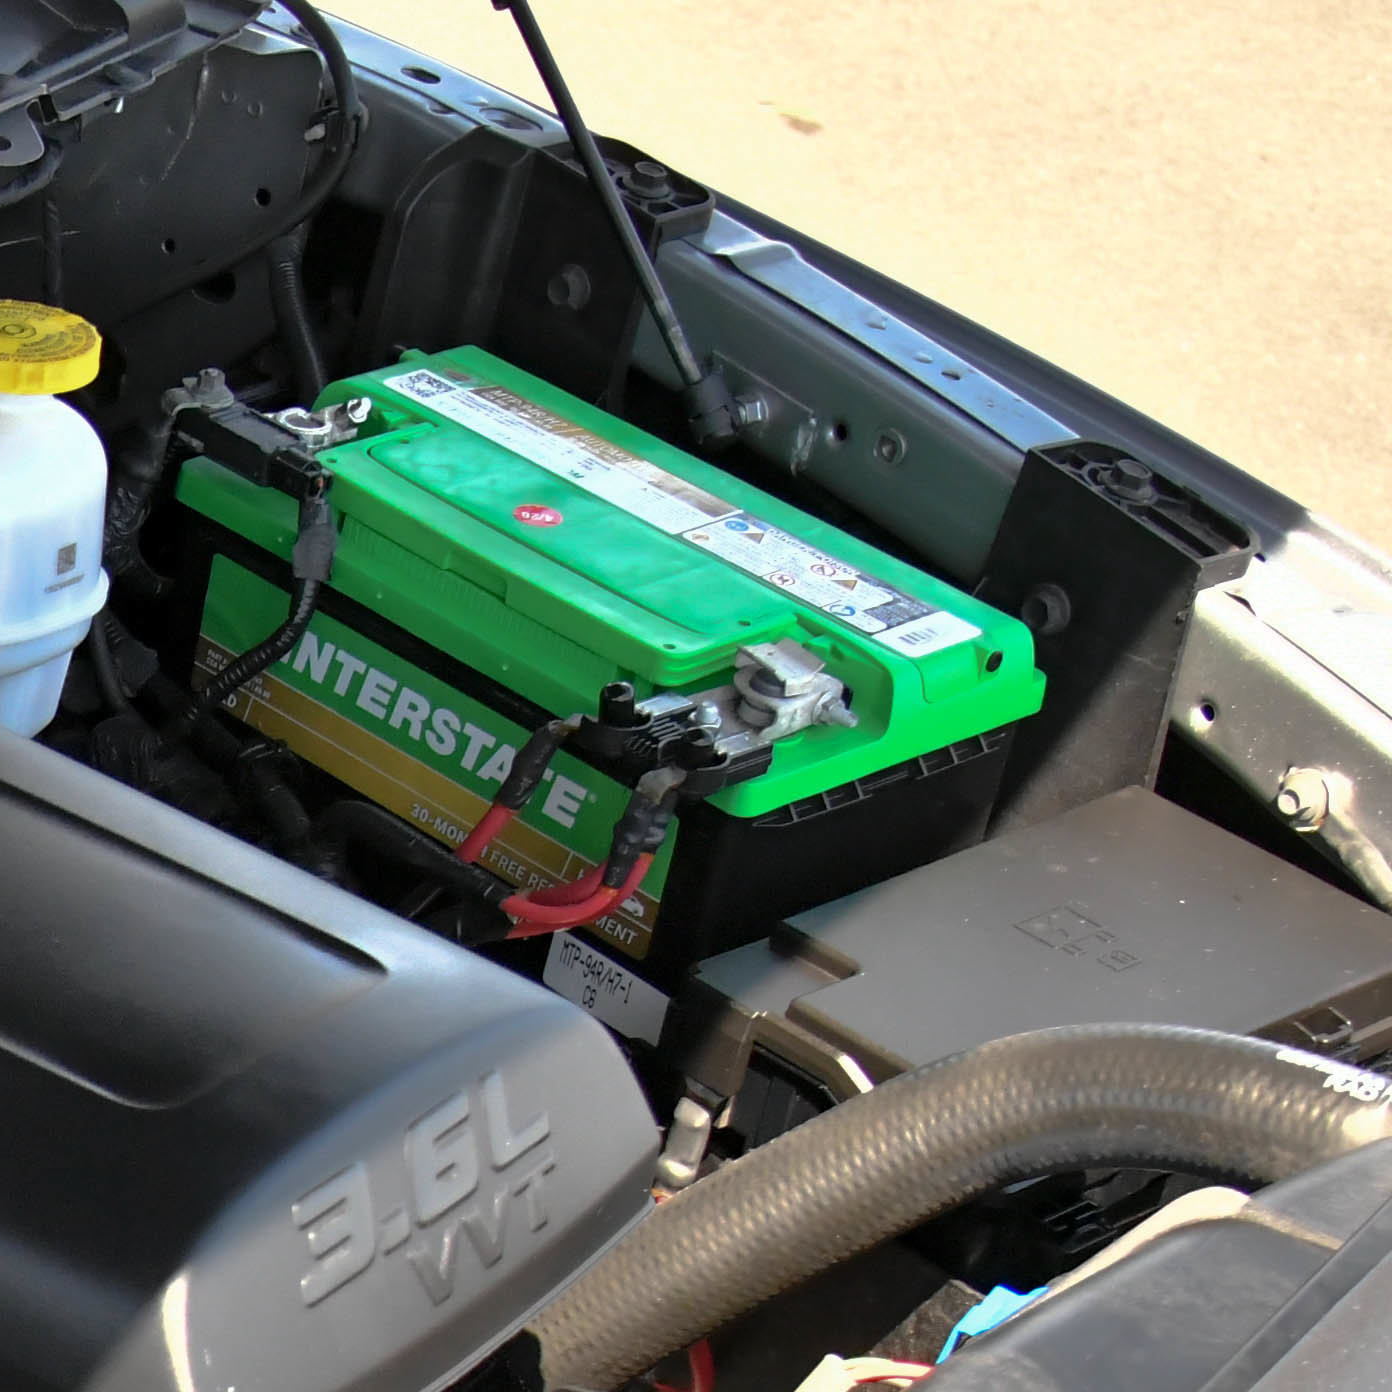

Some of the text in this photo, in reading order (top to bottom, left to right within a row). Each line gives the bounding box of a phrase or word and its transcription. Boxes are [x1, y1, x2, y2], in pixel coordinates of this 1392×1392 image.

[279, 630, 587, 829] NTERSTAE
[291, 1069, 551, 1309] 3.6L
[406, 1156, 557, 1306] VVT
